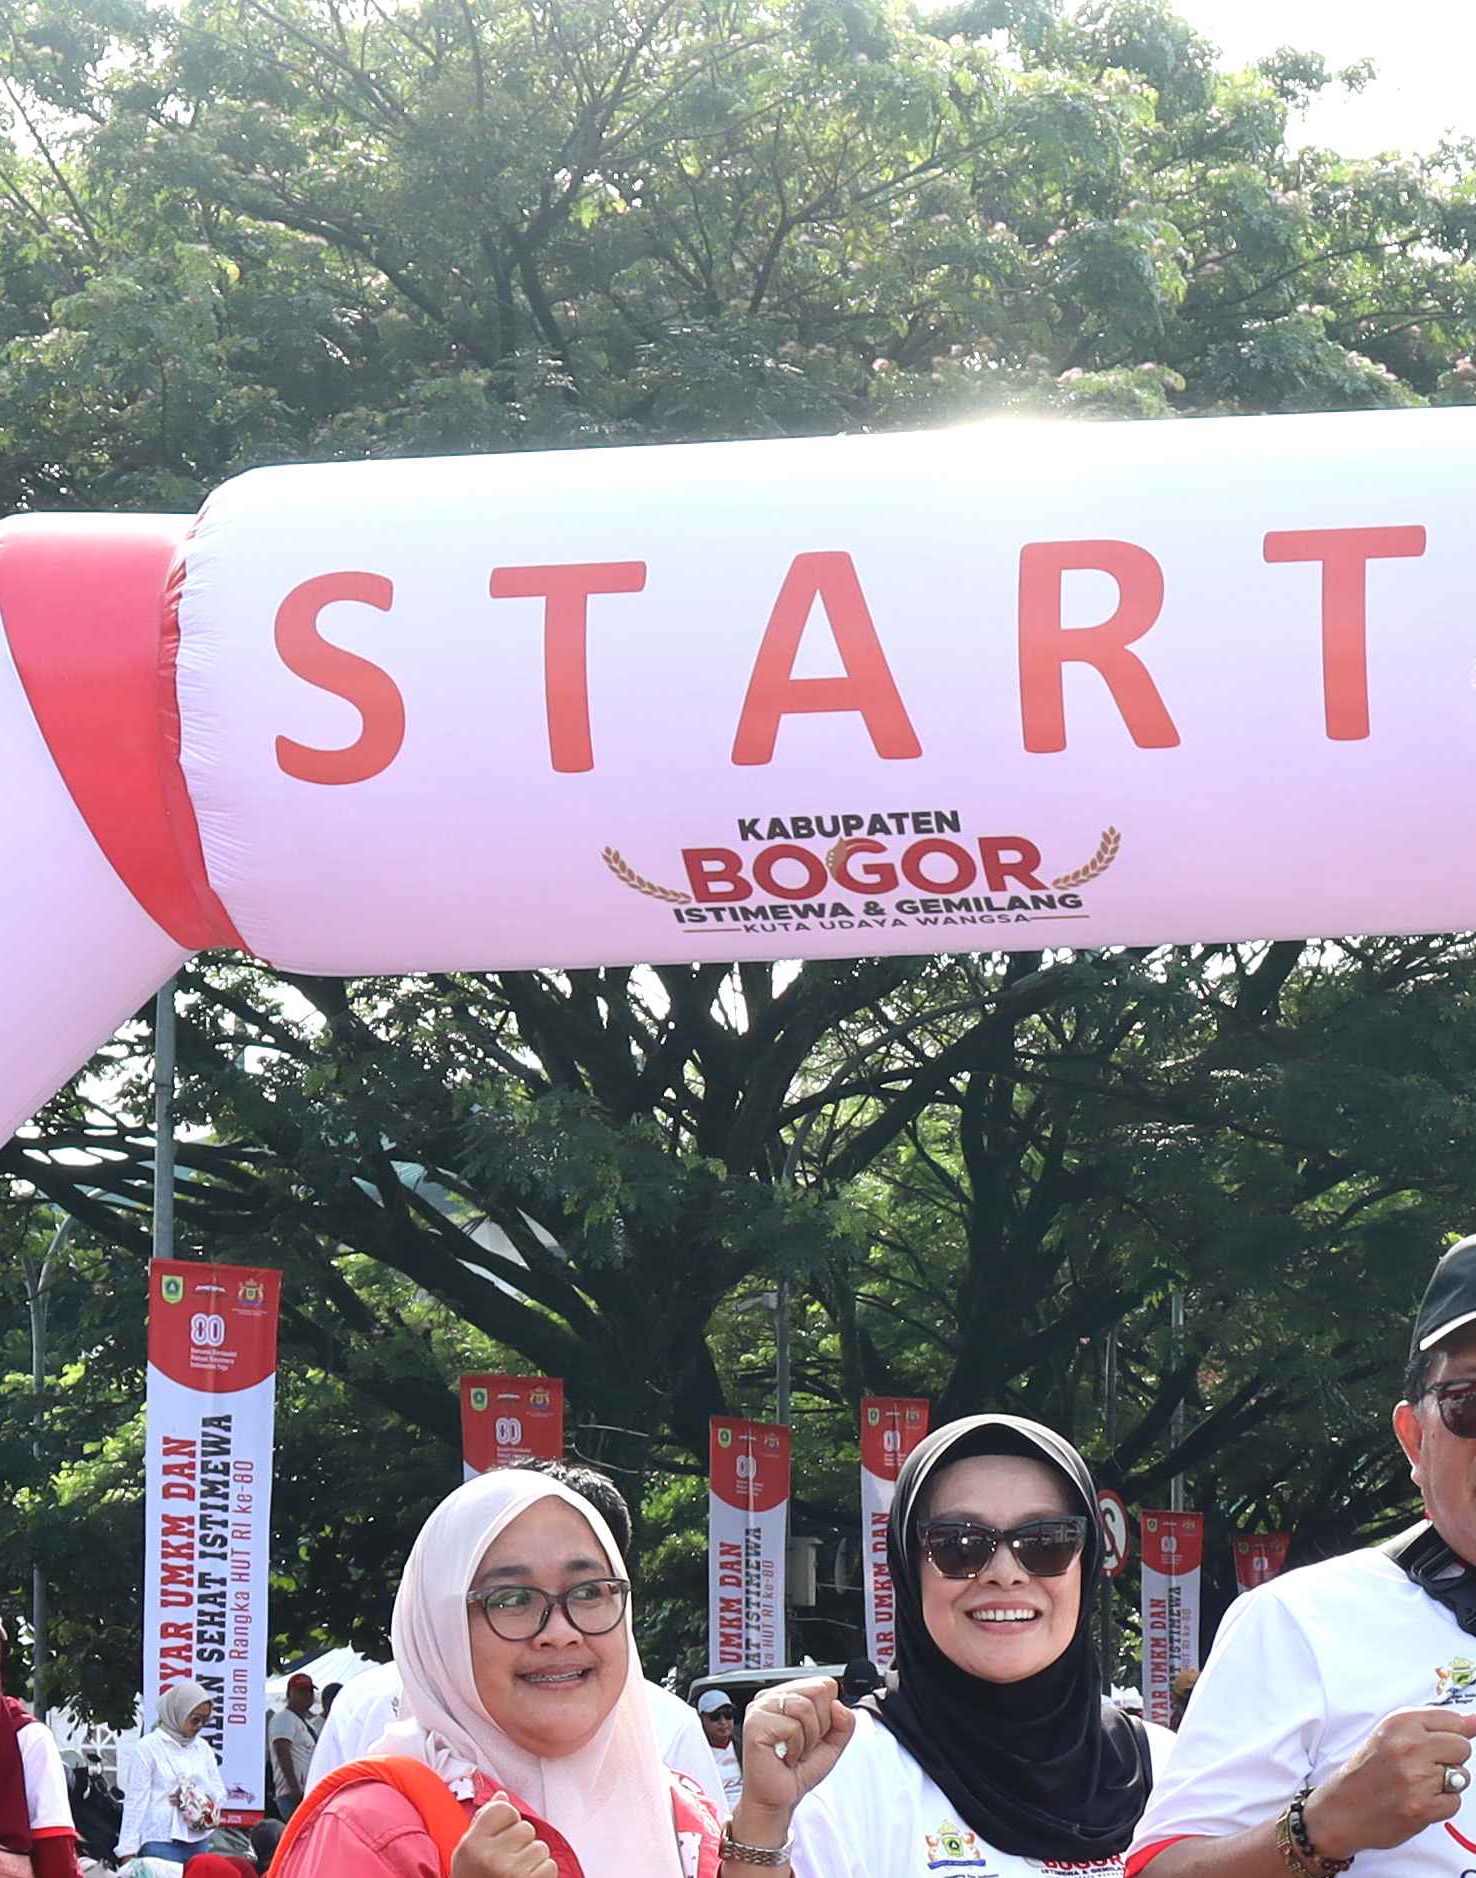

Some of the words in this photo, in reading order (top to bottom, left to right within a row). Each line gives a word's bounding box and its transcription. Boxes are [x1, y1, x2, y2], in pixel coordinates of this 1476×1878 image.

[274, 524, 1427, 786] START
[738, 810, 961, 841] KABUPATEN
[681, 835, 1049, 904] BOGOR
[673, 901, 847, 924] ISTIMEWA
[865, 899, 884, 915] &
[895, 893, 1084, 915] GEMILANG
[742, 921, 812, 934] KUTA
[820, 917, 906, 930] UDAYA
[915, 913, 1030, 926] WANGSA
[162, 1436, 196, 1501] DAN
[198, 1414, 232, 1561] ISTIMEWA
[160, 1513, 195, 1609] UMKM
[231, 1522, 252, 1541] RI
[230, 1547, 252, 1583] HUT
[719, 1541, 742, 1588] DAN
[196, 1572, 227, 1663] SEHAT
[228, 1591, 253, 1661] Rangka
[720, 1599, 743, 1664] UMKM
[228, 1668, 248, 1726] Dalam
